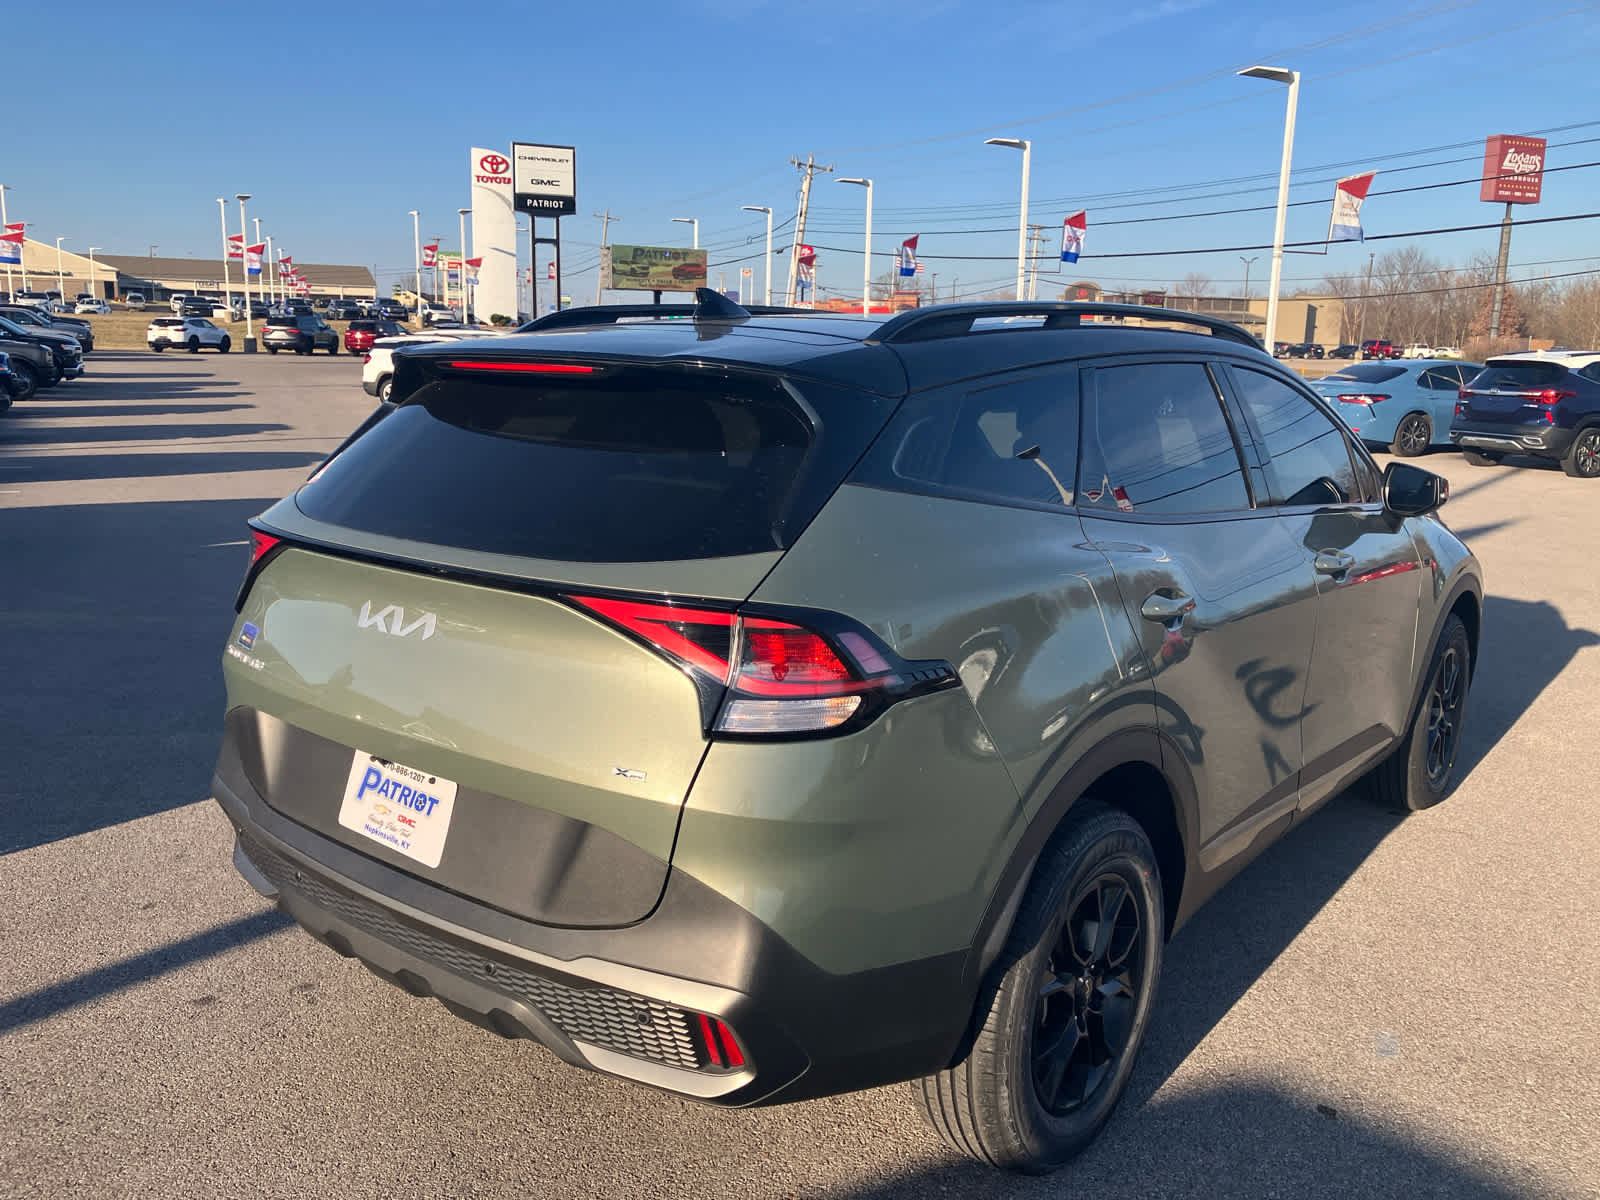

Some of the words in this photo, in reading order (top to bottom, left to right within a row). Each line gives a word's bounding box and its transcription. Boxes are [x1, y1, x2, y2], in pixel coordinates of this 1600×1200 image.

[518, 155, 569, 163] CHEVROLET
[1501, 148, 1542, 175] Logan's
[475, 175, 512, 184] TOYOTA
[530, 178, 561, 187] GMC
[526, 198, 564, 208] PATRIOT
[357, 600, 437, 640] KIA
[357, 765, 440, 816] PATRIOT
[397, 814, 417, 828] GMC
[401, 838, 411, 849] KY
